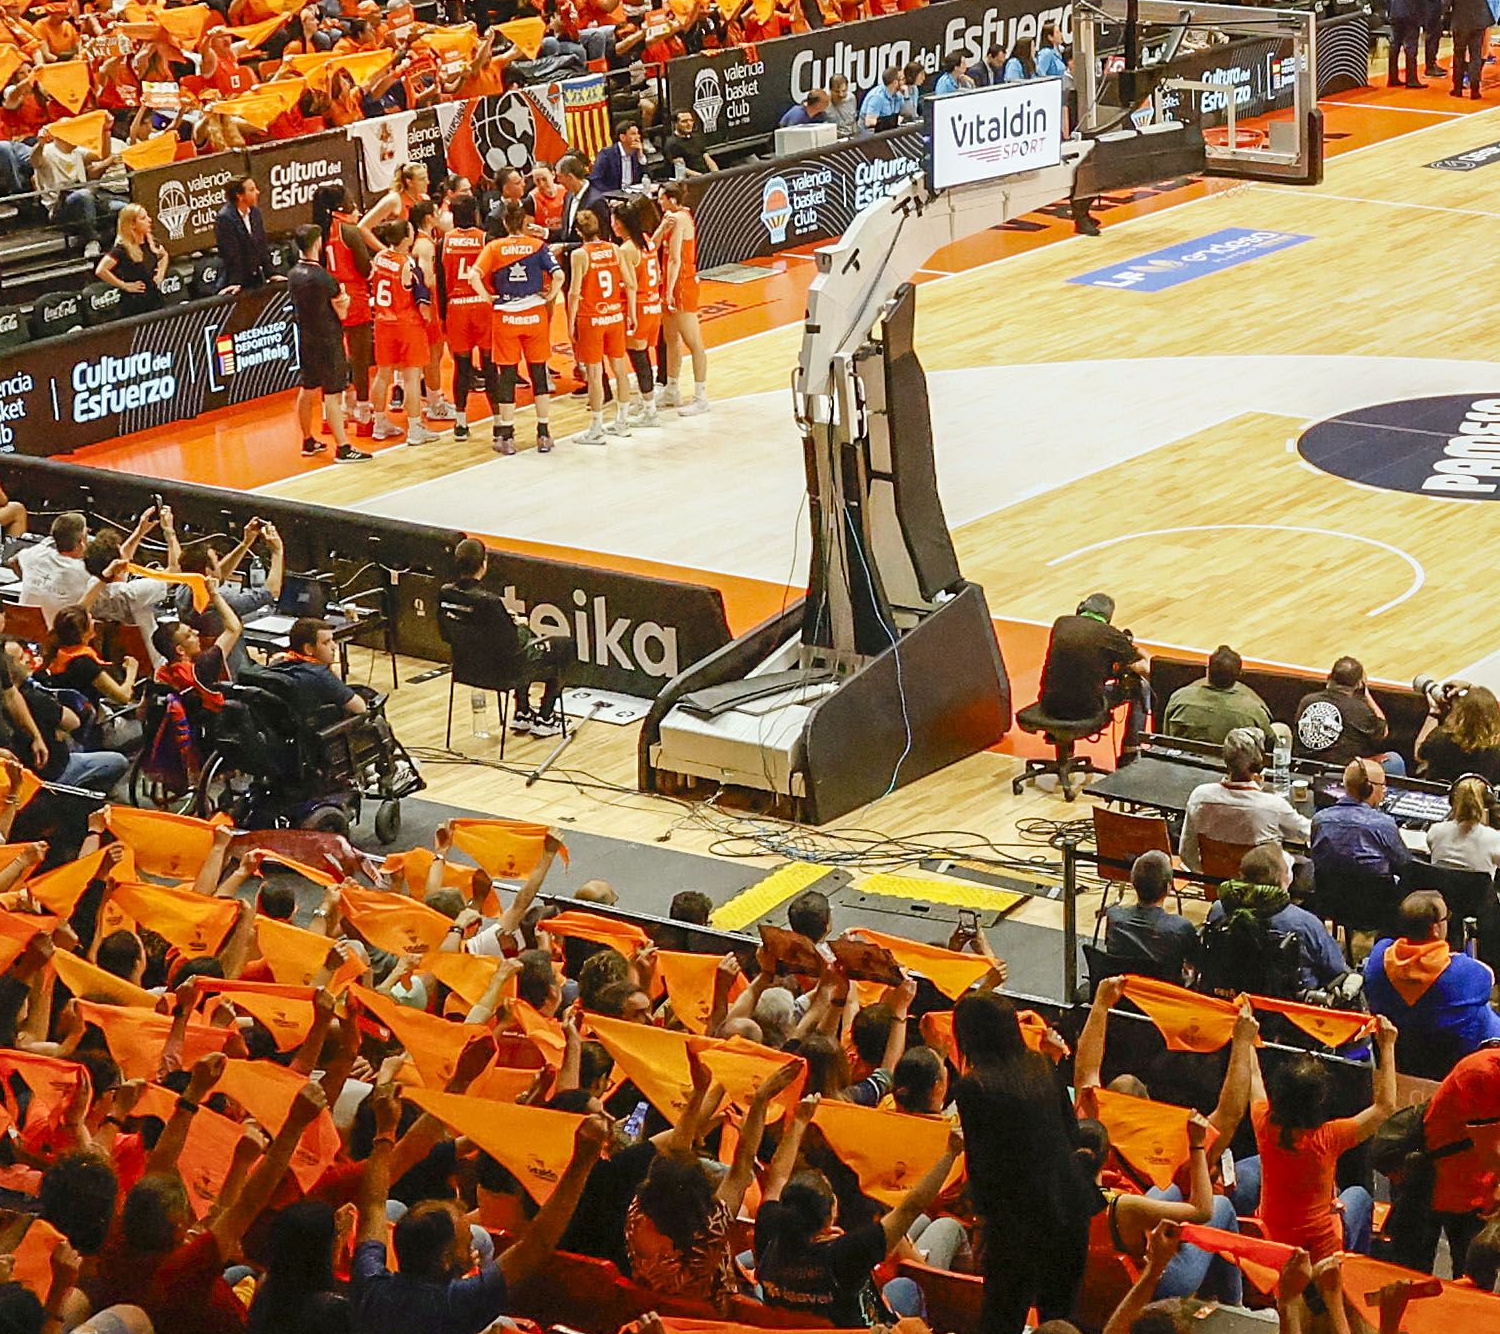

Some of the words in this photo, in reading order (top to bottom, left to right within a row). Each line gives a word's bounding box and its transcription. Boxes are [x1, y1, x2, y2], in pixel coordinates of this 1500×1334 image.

[724, 61, 764, 81] valencia
[790, 41, 911, 104] Cultura
[725, 80, 759, 100] basket
[726, 101, 750, 119] club
[951, 99, 1047, 148] Vitaldin
[1003, 137, 1046, 160] SPORT
[188, 169, 231, 193] valencia
[271, 160, 328, 187] Cultura
[328, 161, 341, 175] del
[791, 168, 832, 190] valencia
[856, 156, 906, 186] Cultura
[189, 190, 227, 211] basket
[793, 186, 826, 209] basket
[192, 208, 217, 229] club
[794, 208, 817, 226] club
[647, 258, 658, 287] 5
[376, 279, 393, 308] 6
[598, 271, 612, 298] 9
[44, 299, 76, 322] Coca-Cola
[234, 322, 288, 344] MECENAZGO
[234, 335, 283, 355] DEPORTIVO
[73, 352, 151, 391] Cultura
[151, 353, 173, 371] del
[236, 352, 261, 376] Juan
[261, 347, 290, 369] Roig
[74, 375, 174, 422] Esfuerzo
